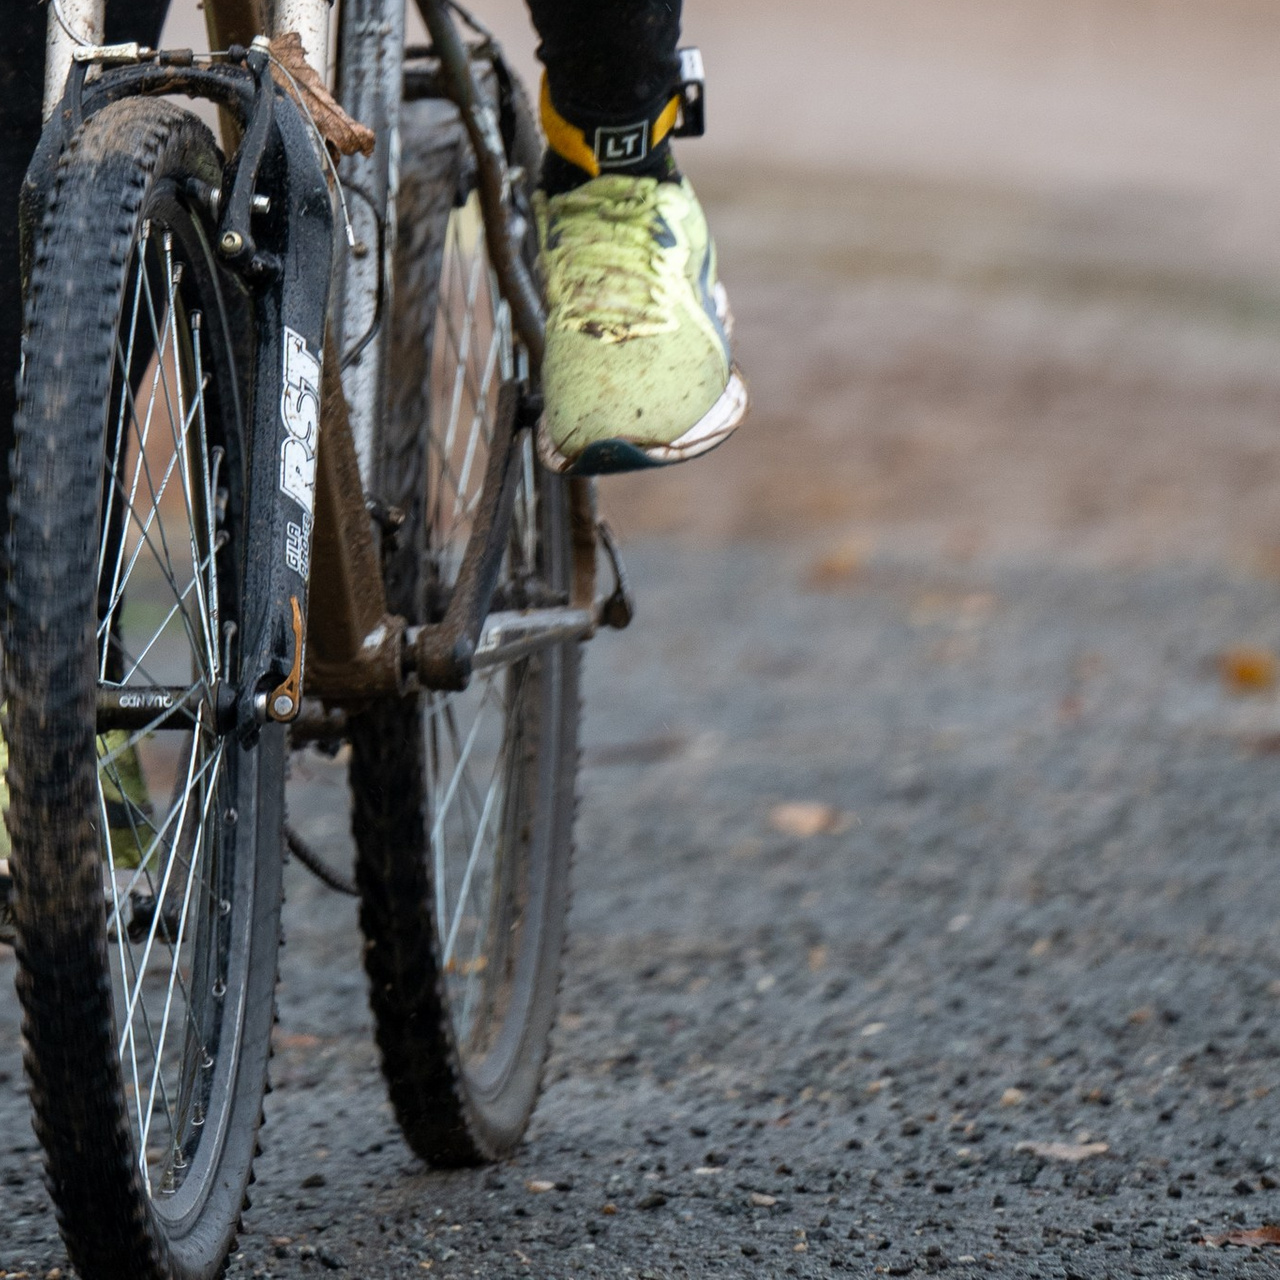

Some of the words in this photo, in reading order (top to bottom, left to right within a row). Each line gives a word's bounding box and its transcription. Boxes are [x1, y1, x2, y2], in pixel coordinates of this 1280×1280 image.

[607, 134, 640, 158] LT
[280, 325, 322, 515] RST
[286, 521, 301, 572] GILA
[119, 690, 175, 708] QUANDO
